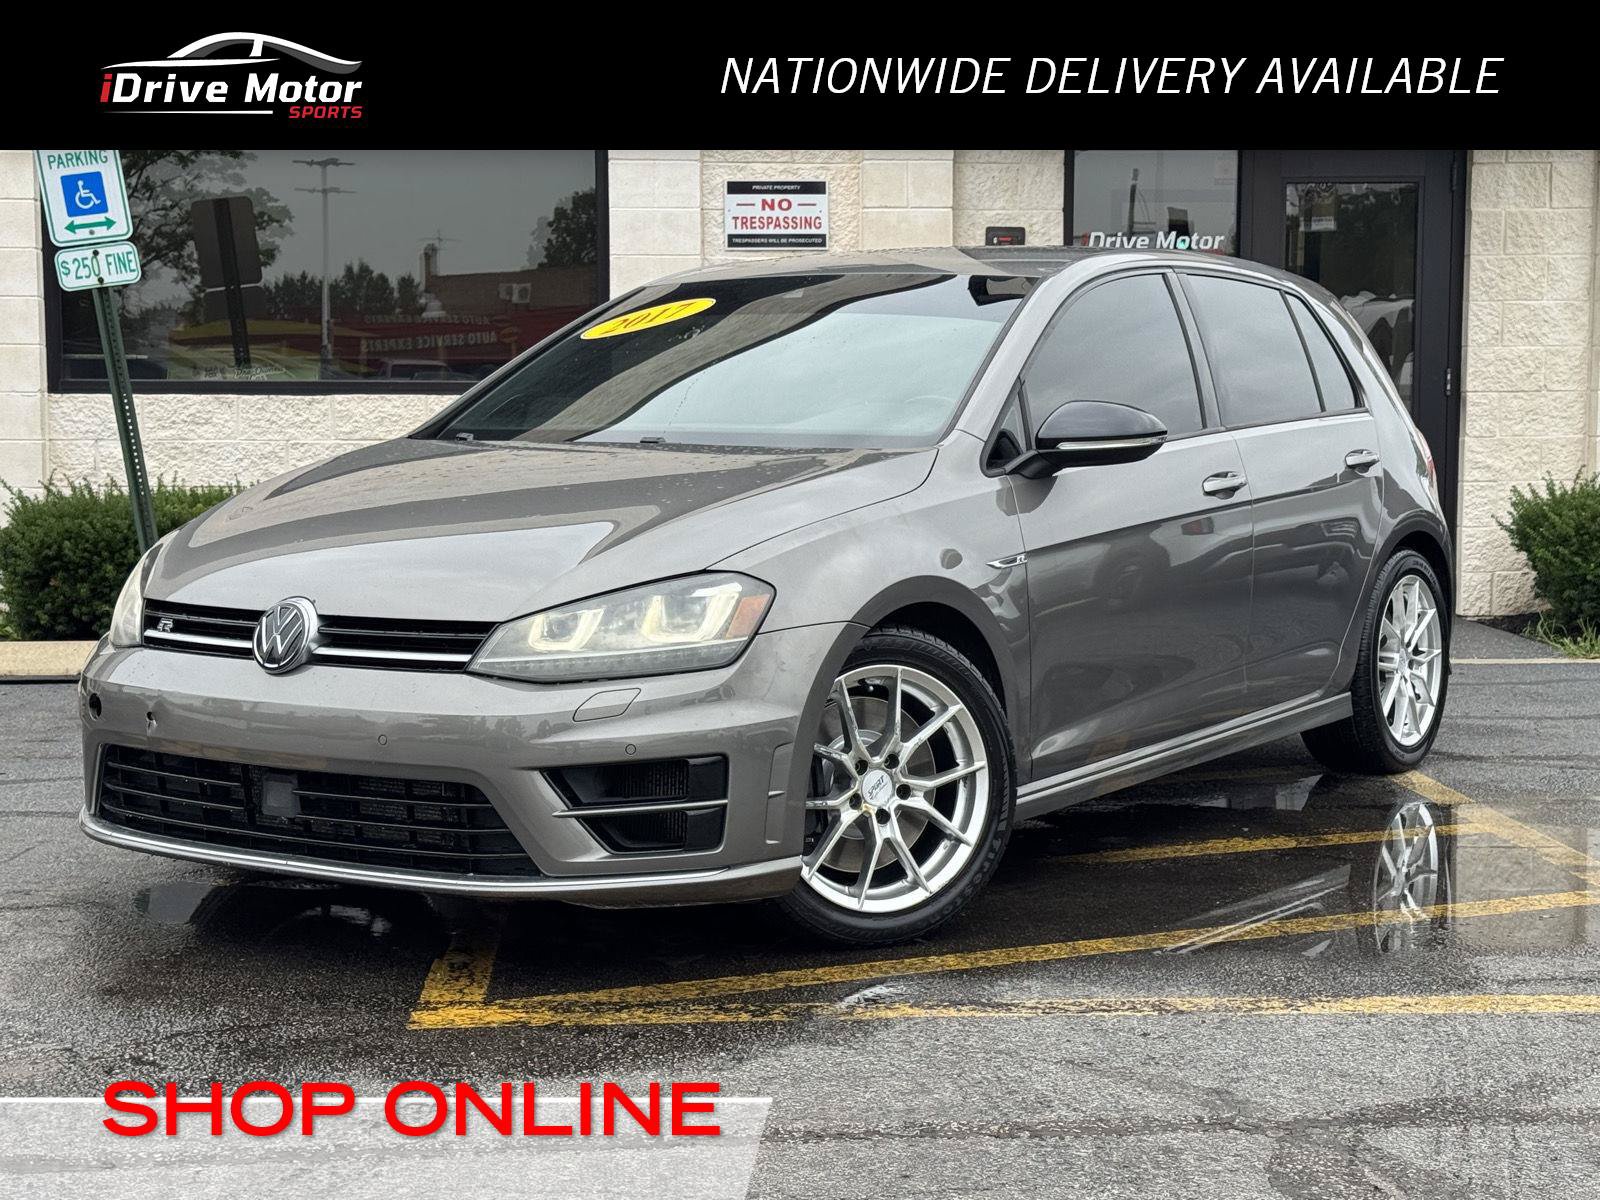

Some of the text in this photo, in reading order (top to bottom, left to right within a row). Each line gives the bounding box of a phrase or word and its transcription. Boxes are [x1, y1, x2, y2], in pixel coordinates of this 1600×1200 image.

[47, 150, 108, 170] PARKING
[761, 198, 793, 212] NO
[731, 216, 823, 230] TRESPASSING
[1155, 230, 1225, 250] Motor
[60, 251, 137, 280] $250 FINE
[599, 301, 698, 335] 2017
[156, 617, 174, 633] R
